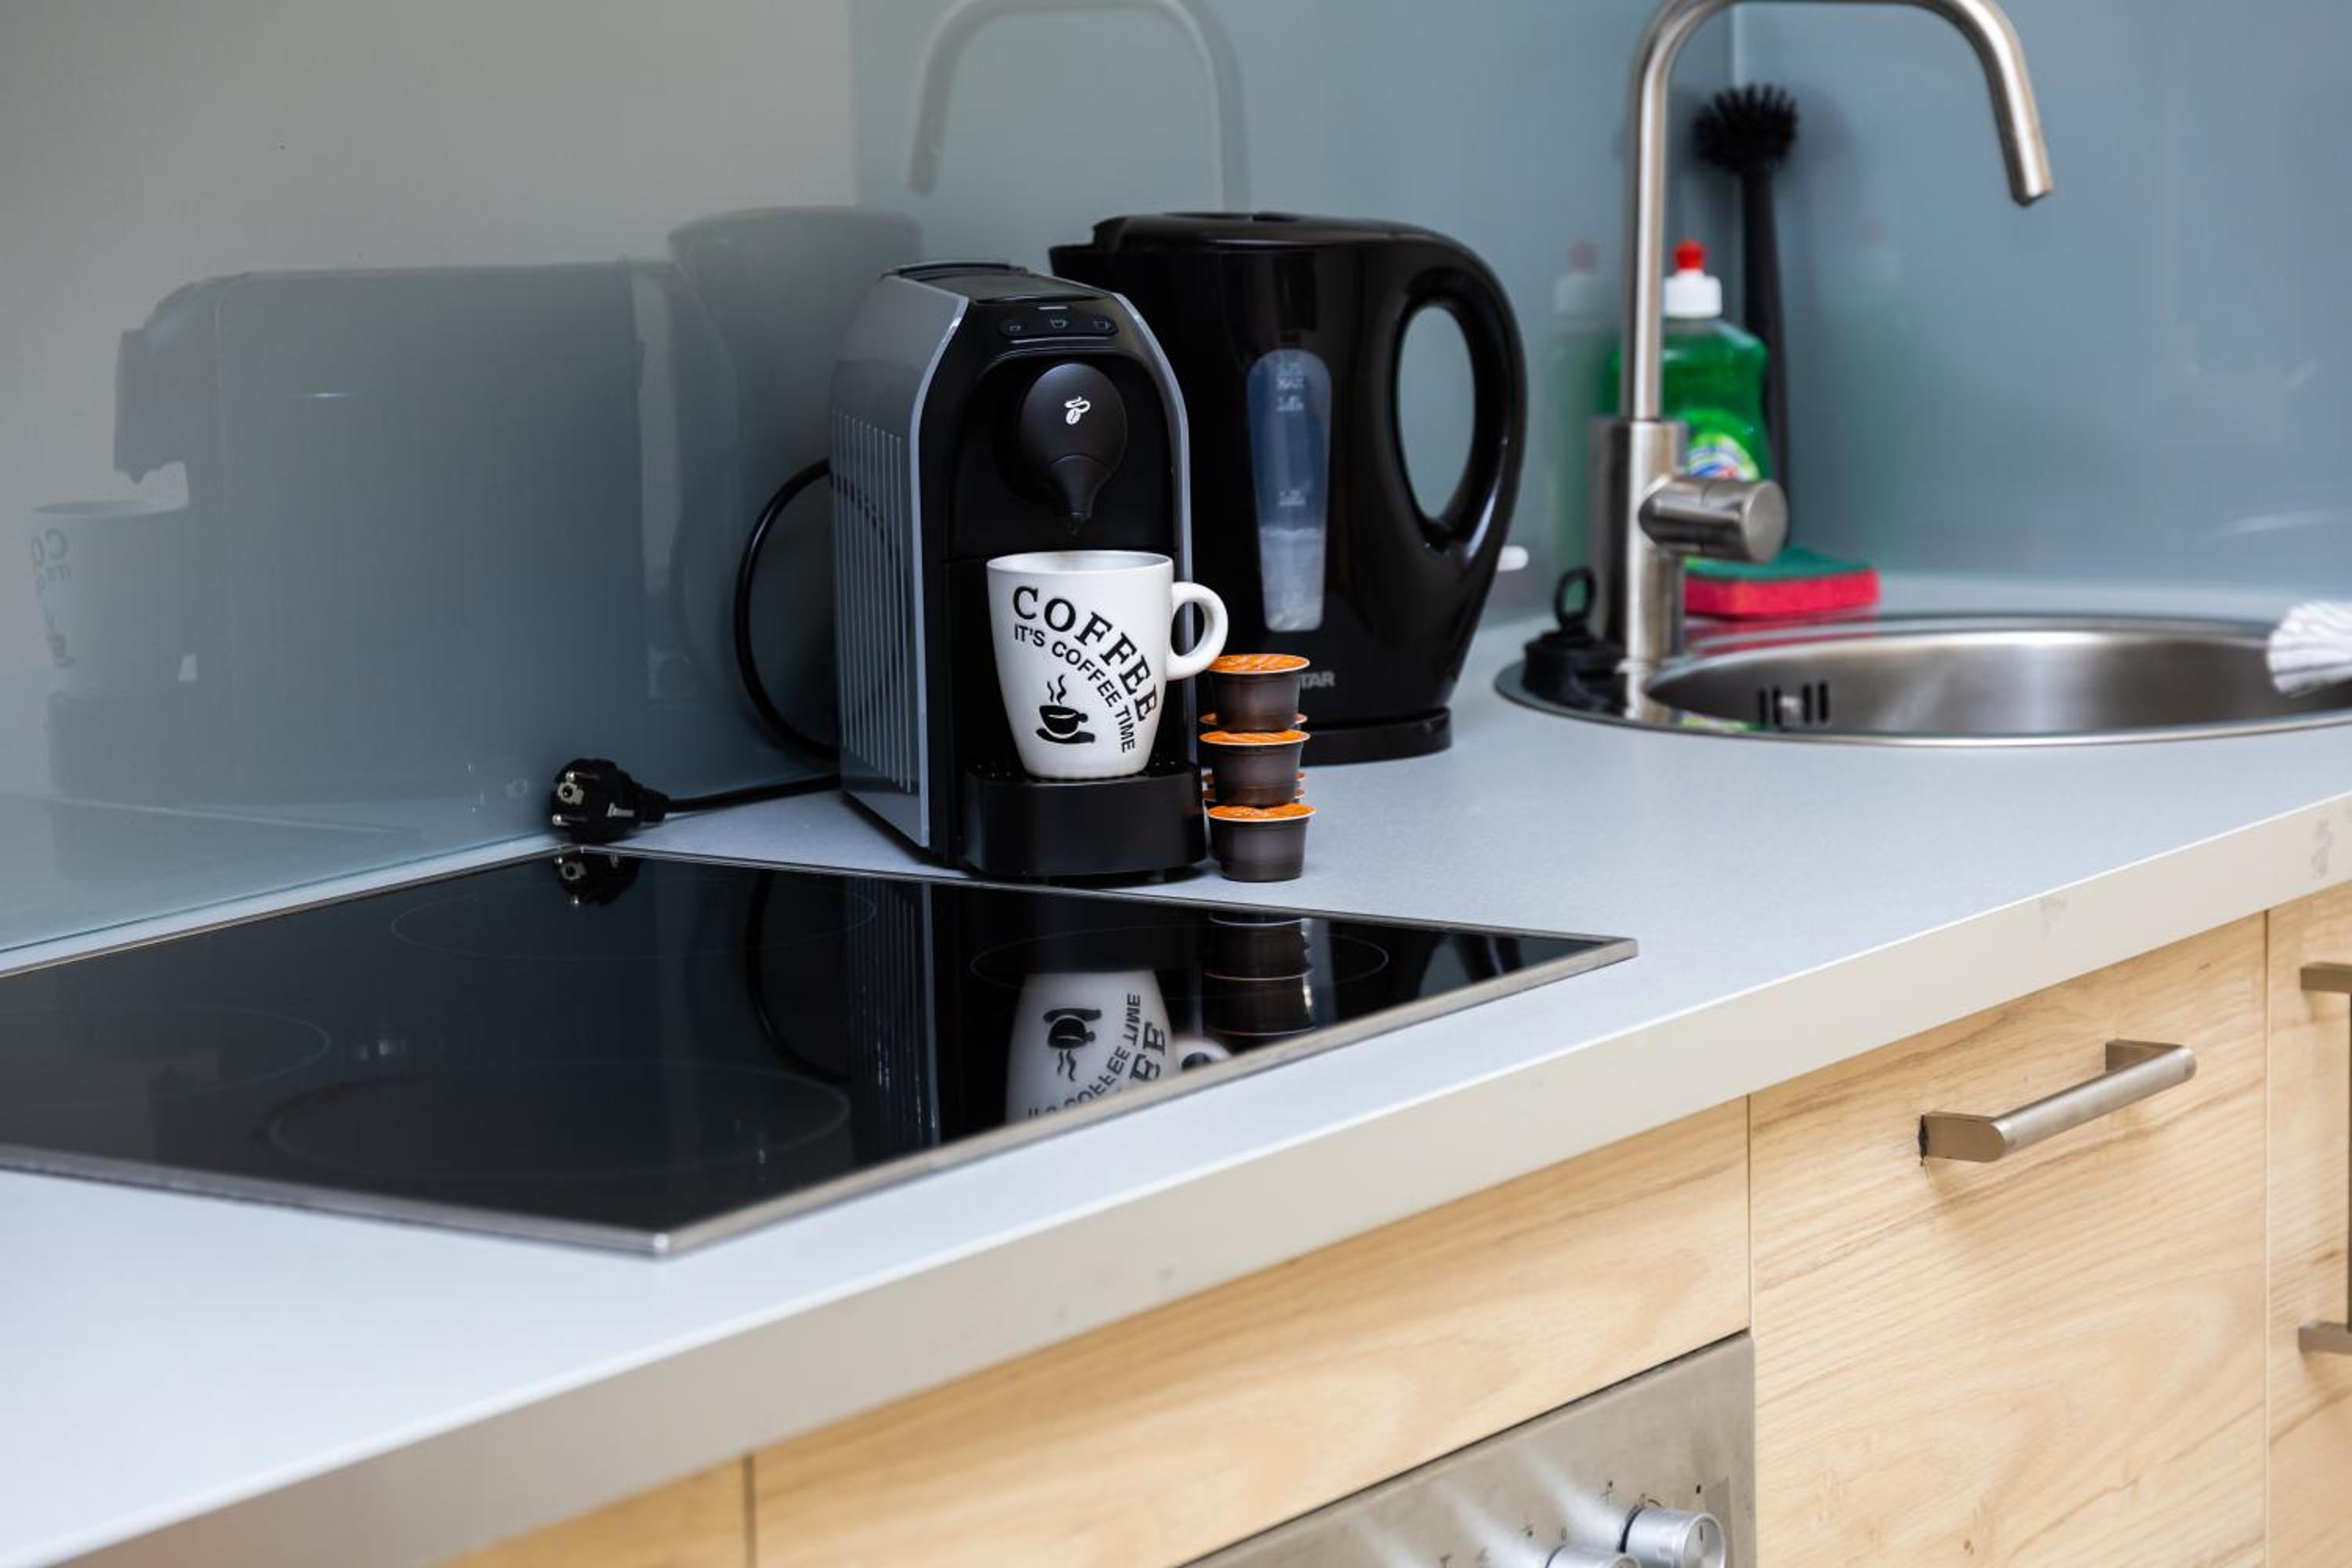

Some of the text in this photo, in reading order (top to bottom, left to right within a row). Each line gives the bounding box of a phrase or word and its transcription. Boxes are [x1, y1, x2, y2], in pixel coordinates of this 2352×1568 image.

[1011, 585, 1158, 722] COFFEE
[1014, 622, 1135, 753] IT'S COFFEE TIME
[1297, 670, 1335, 690] TAR
